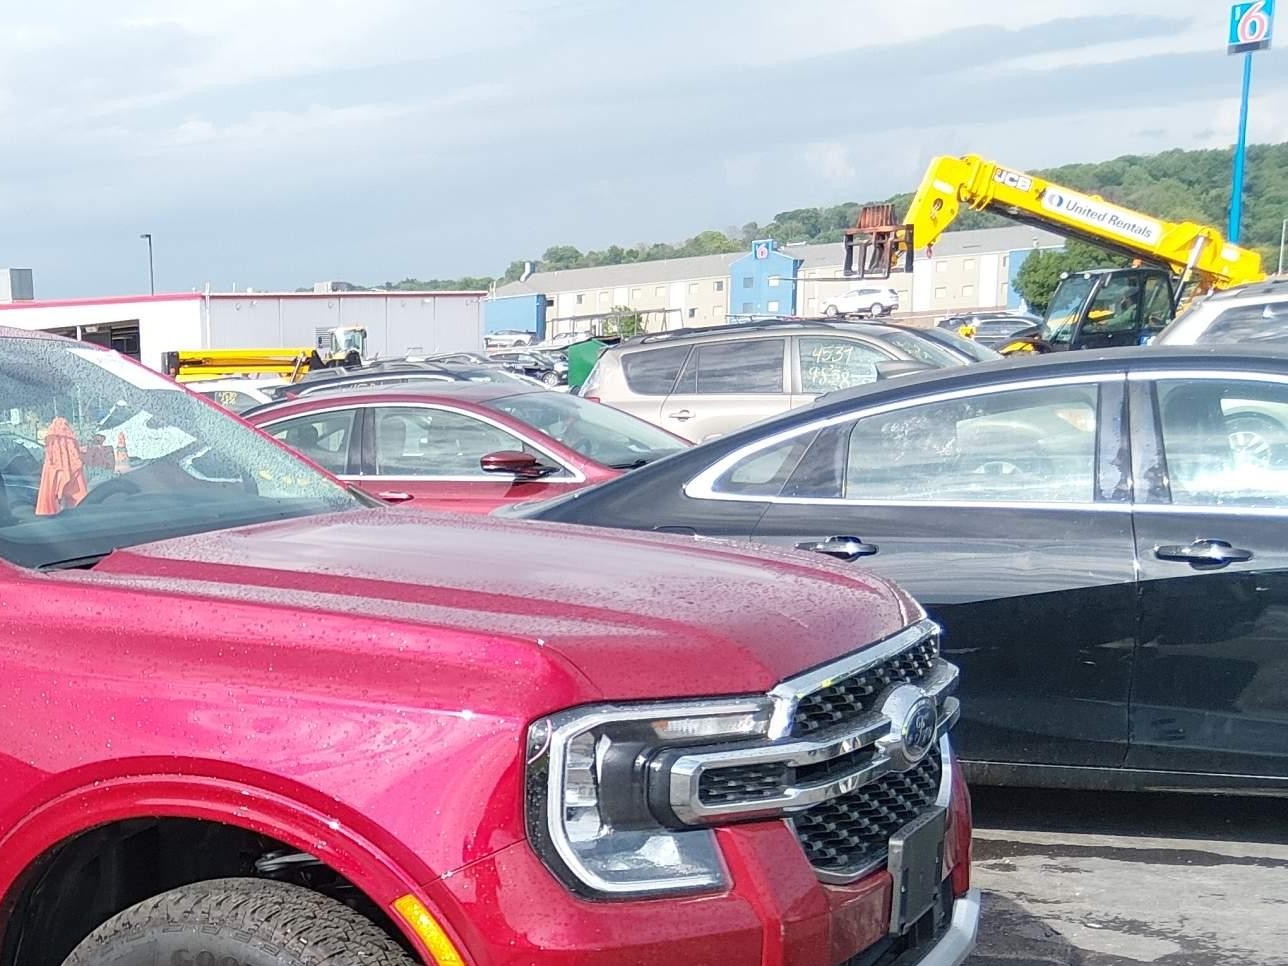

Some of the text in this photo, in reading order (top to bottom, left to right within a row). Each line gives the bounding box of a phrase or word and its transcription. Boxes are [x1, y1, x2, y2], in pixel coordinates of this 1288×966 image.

[1238, 0, 1267, 43] 6
[994, 168, 1032, 192] JCB
[1065, 199, 1153, 239] United Rentals
